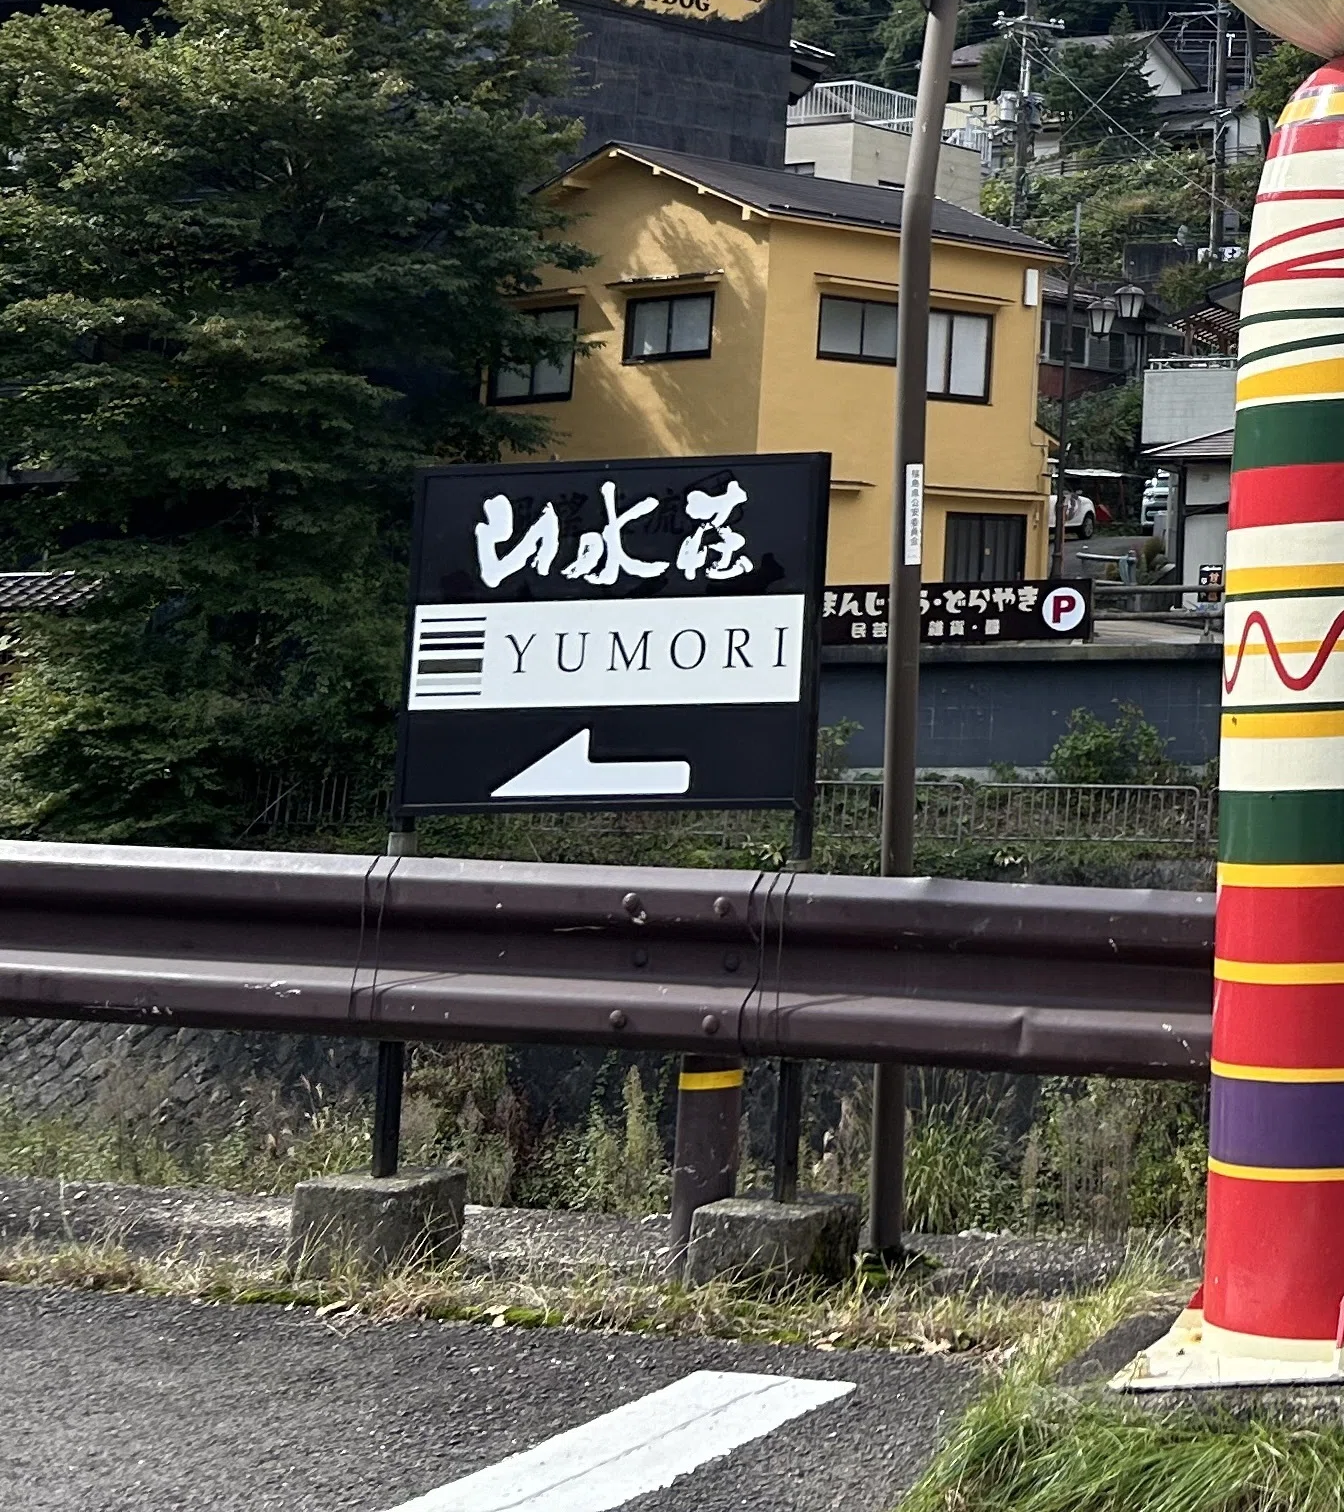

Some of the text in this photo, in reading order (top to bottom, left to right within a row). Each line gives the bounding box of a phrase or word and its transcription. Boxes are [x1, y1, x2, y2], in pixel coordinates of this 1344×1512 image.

[474, 480, 754, 588] 山水荘
[1052, 595, 1076, 623] P
[505, 626, 789, 674] YUMORI
